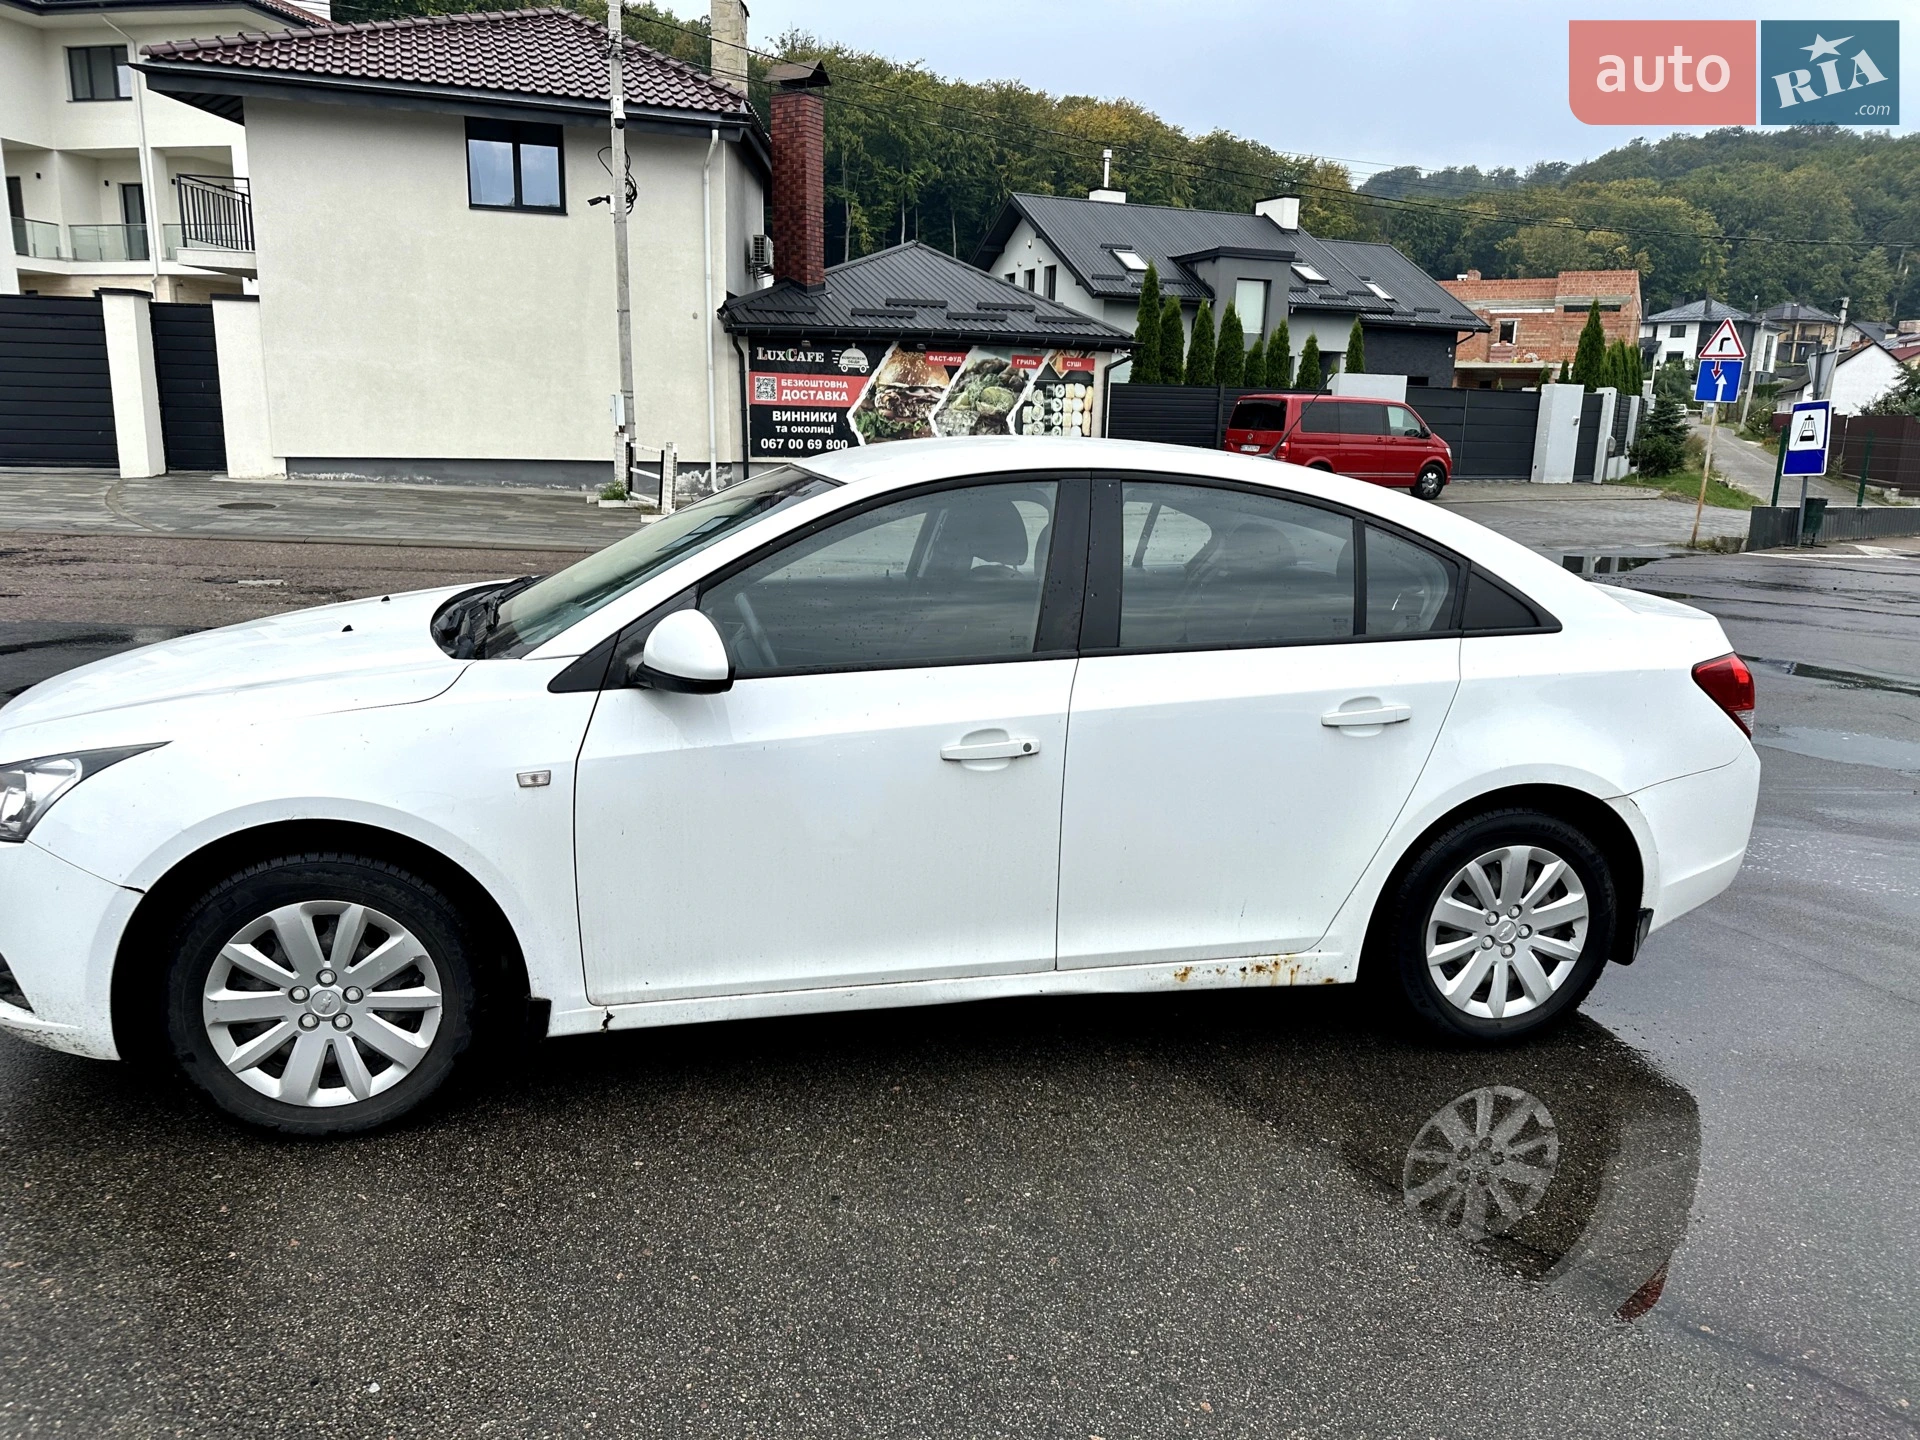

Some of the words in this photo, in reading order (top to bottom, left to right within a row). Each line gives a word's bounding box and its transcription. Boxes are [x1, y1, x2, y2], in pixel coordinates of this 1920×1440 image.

[928, 355, 962, 363] ФАСТ-ФУД
[1016, 358, 1037, 366] ГРИЛЬ
[781, 379, 848, 388] БЕЗКОШТОВНА
[782, 390, 848, 401] ДОСТАВКА
[772, 410, 837, 422] ВИННИКИ
[775, 425, 788, 433] та
[791, 425, 834, 435] околиці
[761, 438, 784, 449] 067
[788, 439, 804, 449] 00
[807, 439, 823, 449] 69
[826, 439, 848, 449] 800
